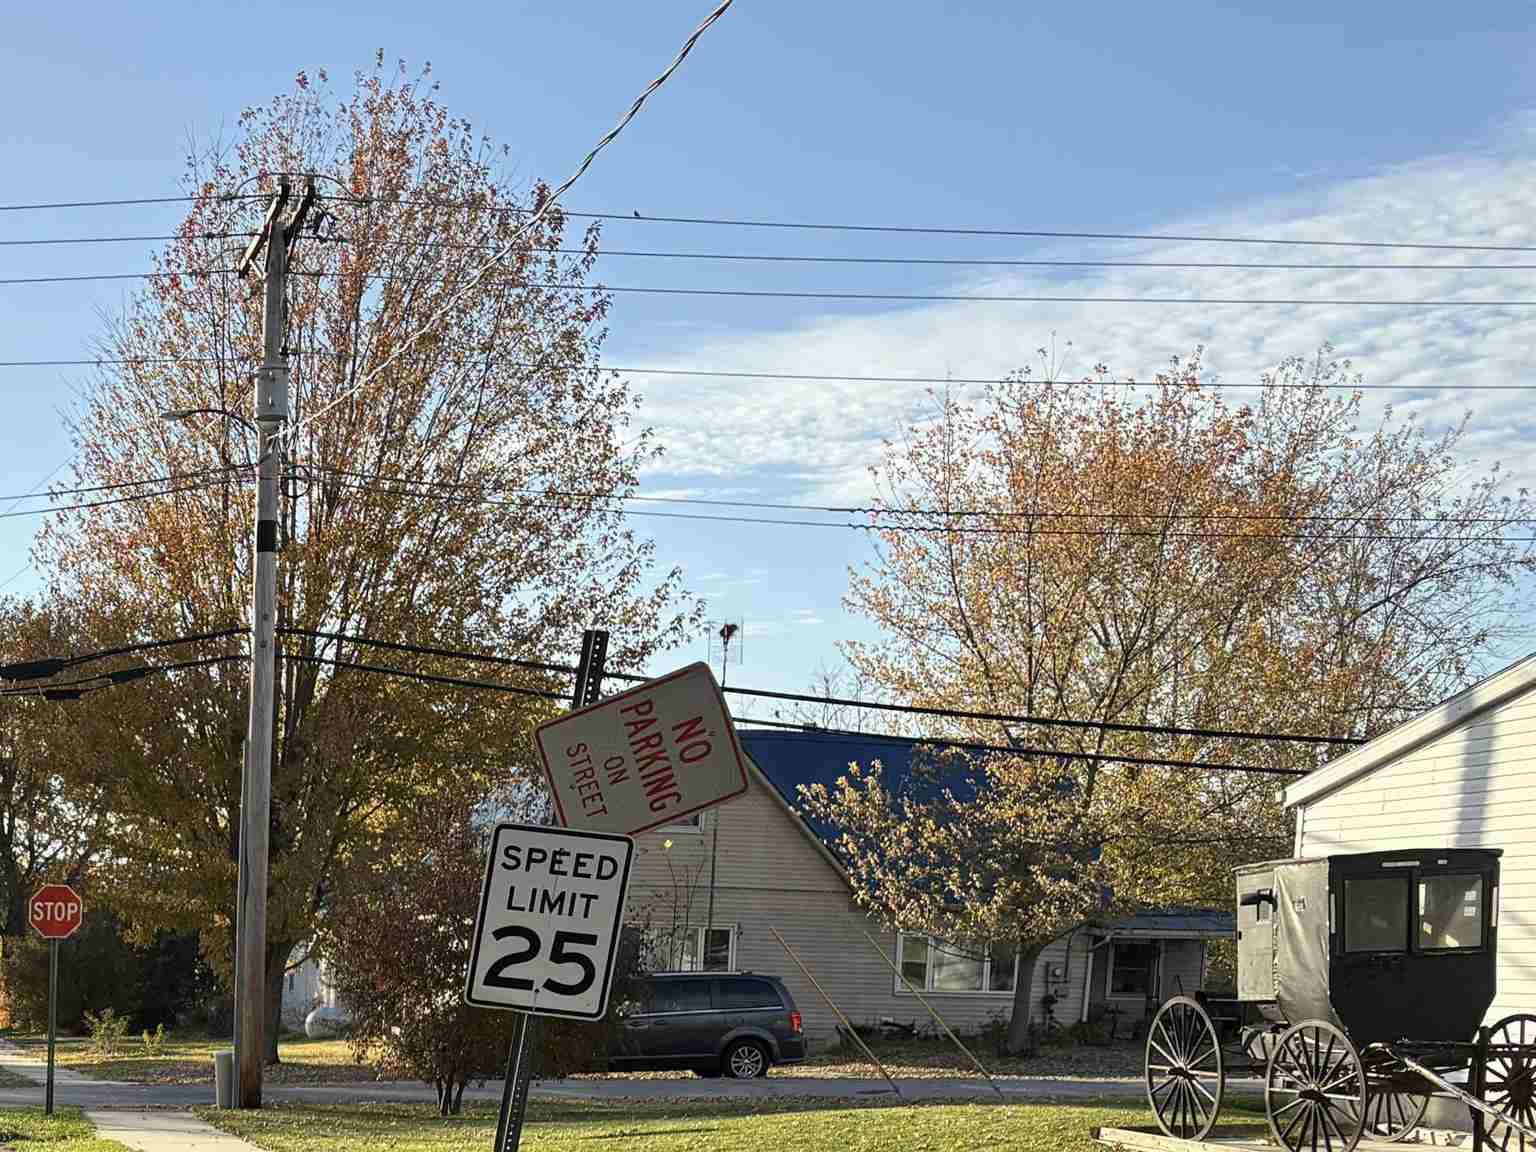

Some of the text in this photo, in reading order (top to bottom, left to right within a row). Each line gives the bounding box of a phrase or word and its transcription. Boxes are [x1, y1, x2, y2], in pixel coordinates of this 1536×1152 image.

[620, 699, 683, 813] PARKING
[671, 715, 712, 764] NO
[565, 742, 609, 817] STREET
[603, 754, 631, 786] ON
[500, 844, 619, 881] SPEED
[33, 901, 79, 921] STOP
[506, 885, 599, 919] LIMIT
[482, 925, 598, 996] 25
